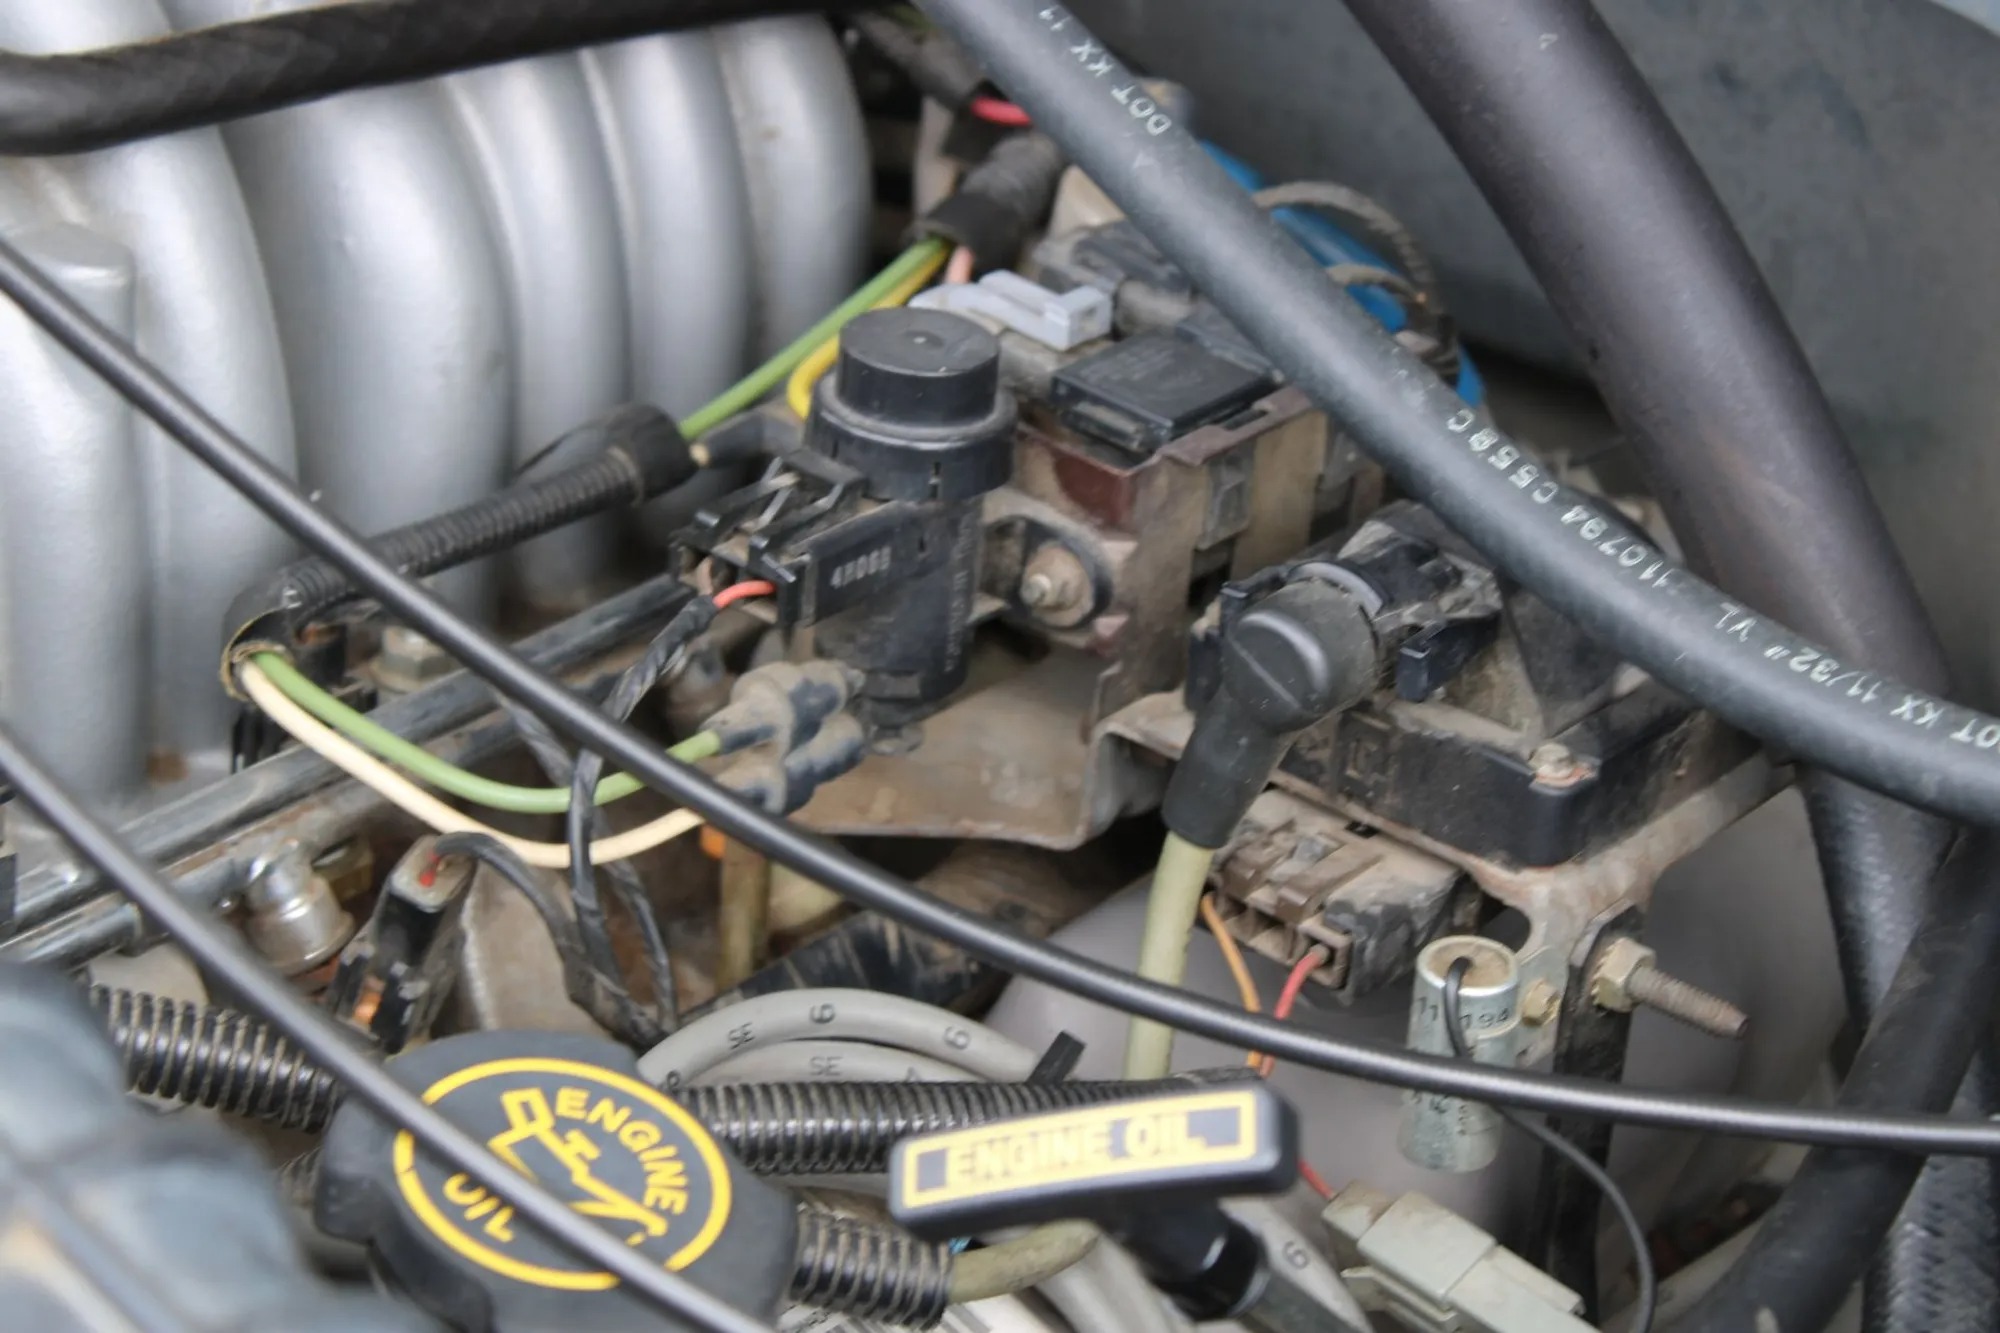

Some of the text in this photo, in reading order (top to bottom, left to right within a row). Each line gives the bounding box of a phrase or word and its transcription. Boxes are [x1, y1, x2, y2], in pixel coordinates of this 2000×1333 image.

[1070, 38, 1114, 78] KX
[1111, 84, 1172, 136] DOT
[1890, 694, 1945, 730] KX
[1949, 718, 2000, 753] OT
[809, 1056, 843, 1077] SE
[442, 1086, 690, 1243] ENGINE OIL
[946, 1108, 1208, 1186] ENGINE OIL
